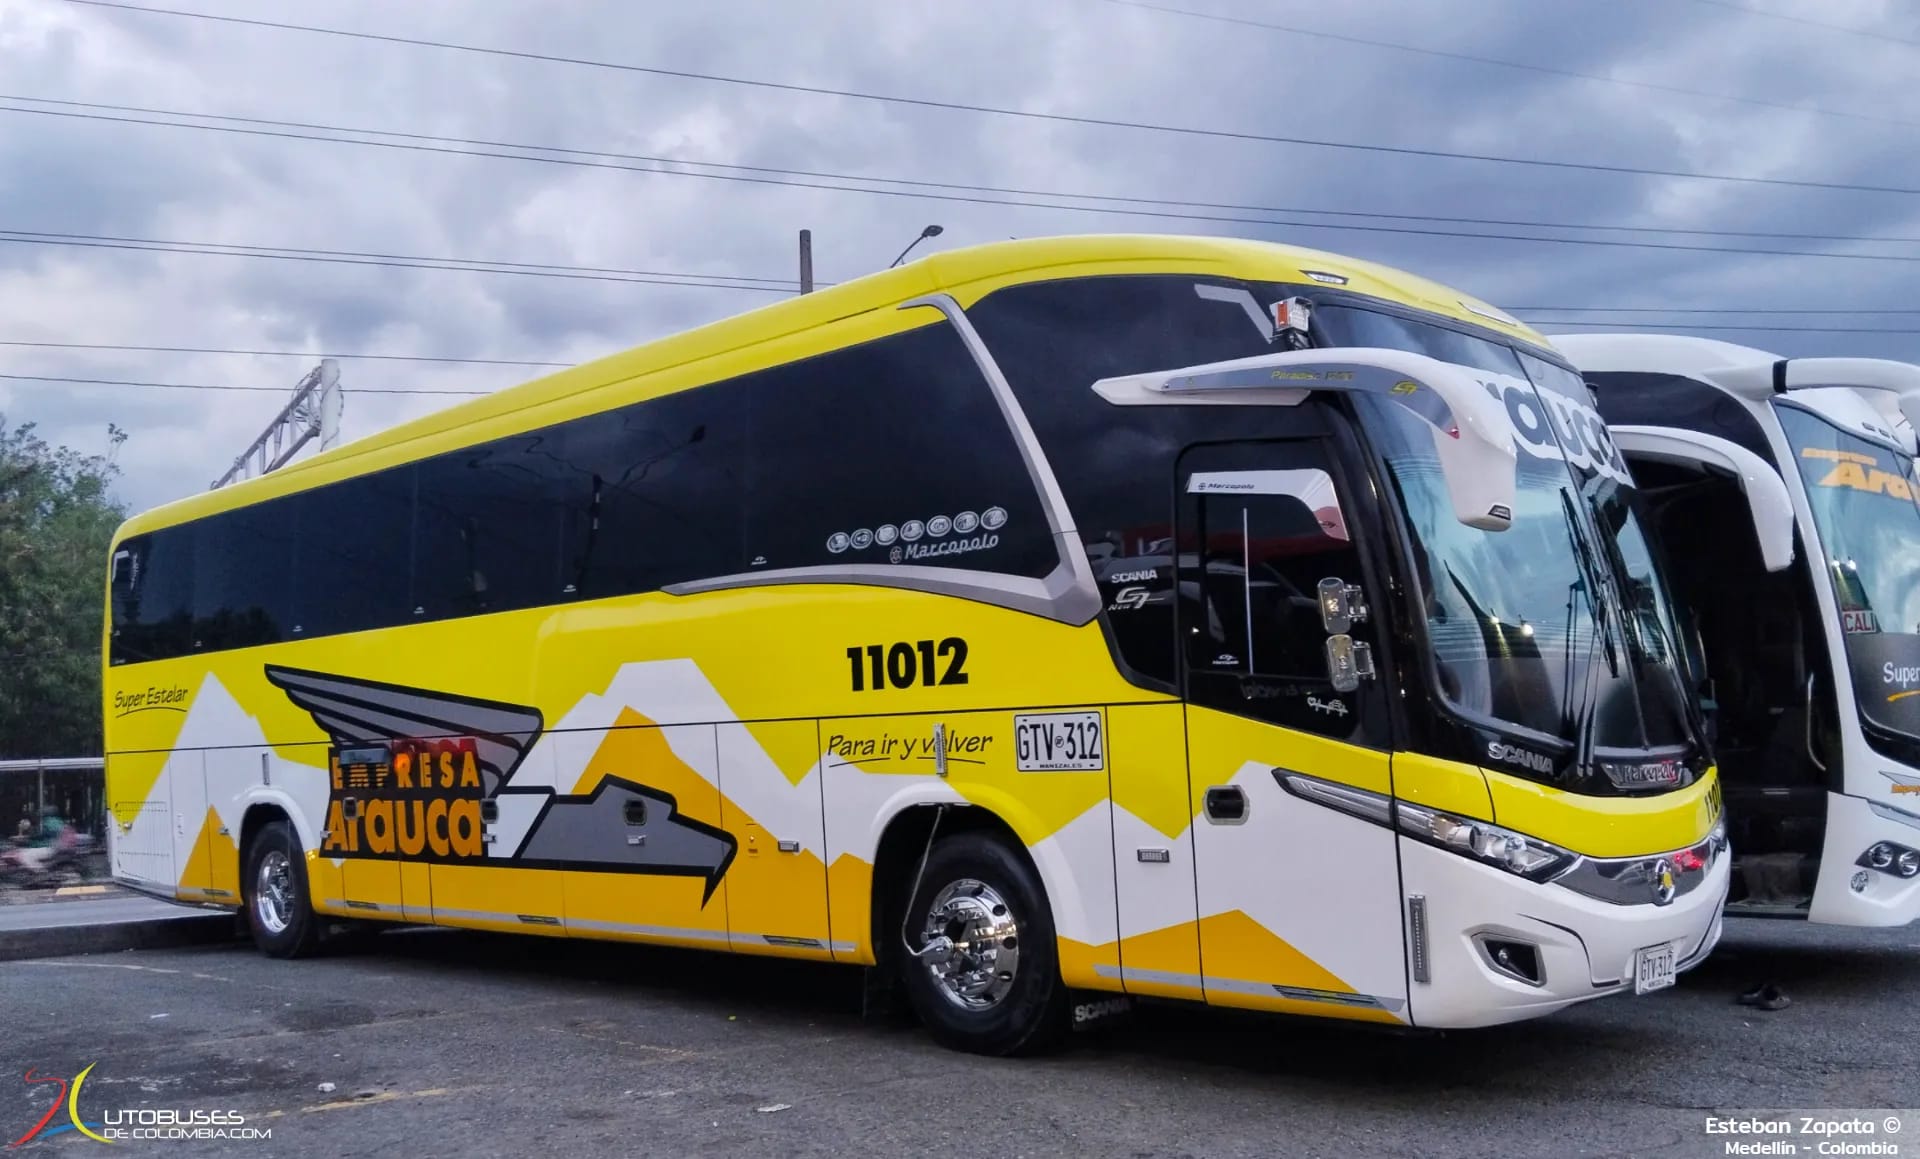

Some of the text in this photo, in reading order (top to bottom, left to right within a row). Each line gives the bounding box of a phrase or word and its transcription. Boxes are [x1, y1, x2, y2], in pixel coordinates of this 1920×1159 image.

[904, 534, 999, 559] Marcopolo
[1111, 569, 1158, 583] SCANIA
[1844, 612, 1876, 632] CALI
[847, 637, 968, 691] 11012
[1883, 661, 1920, 688] Super
[115, 683, 188, 712] Super Estelar
[828, 735, 875, 756] Para
[881, 733, 898, 754] ir
[900, 738, 917, 760] y
[1488, 741, 1554, 776] SCANIA
[325, 798, 483, 857] Arauca
